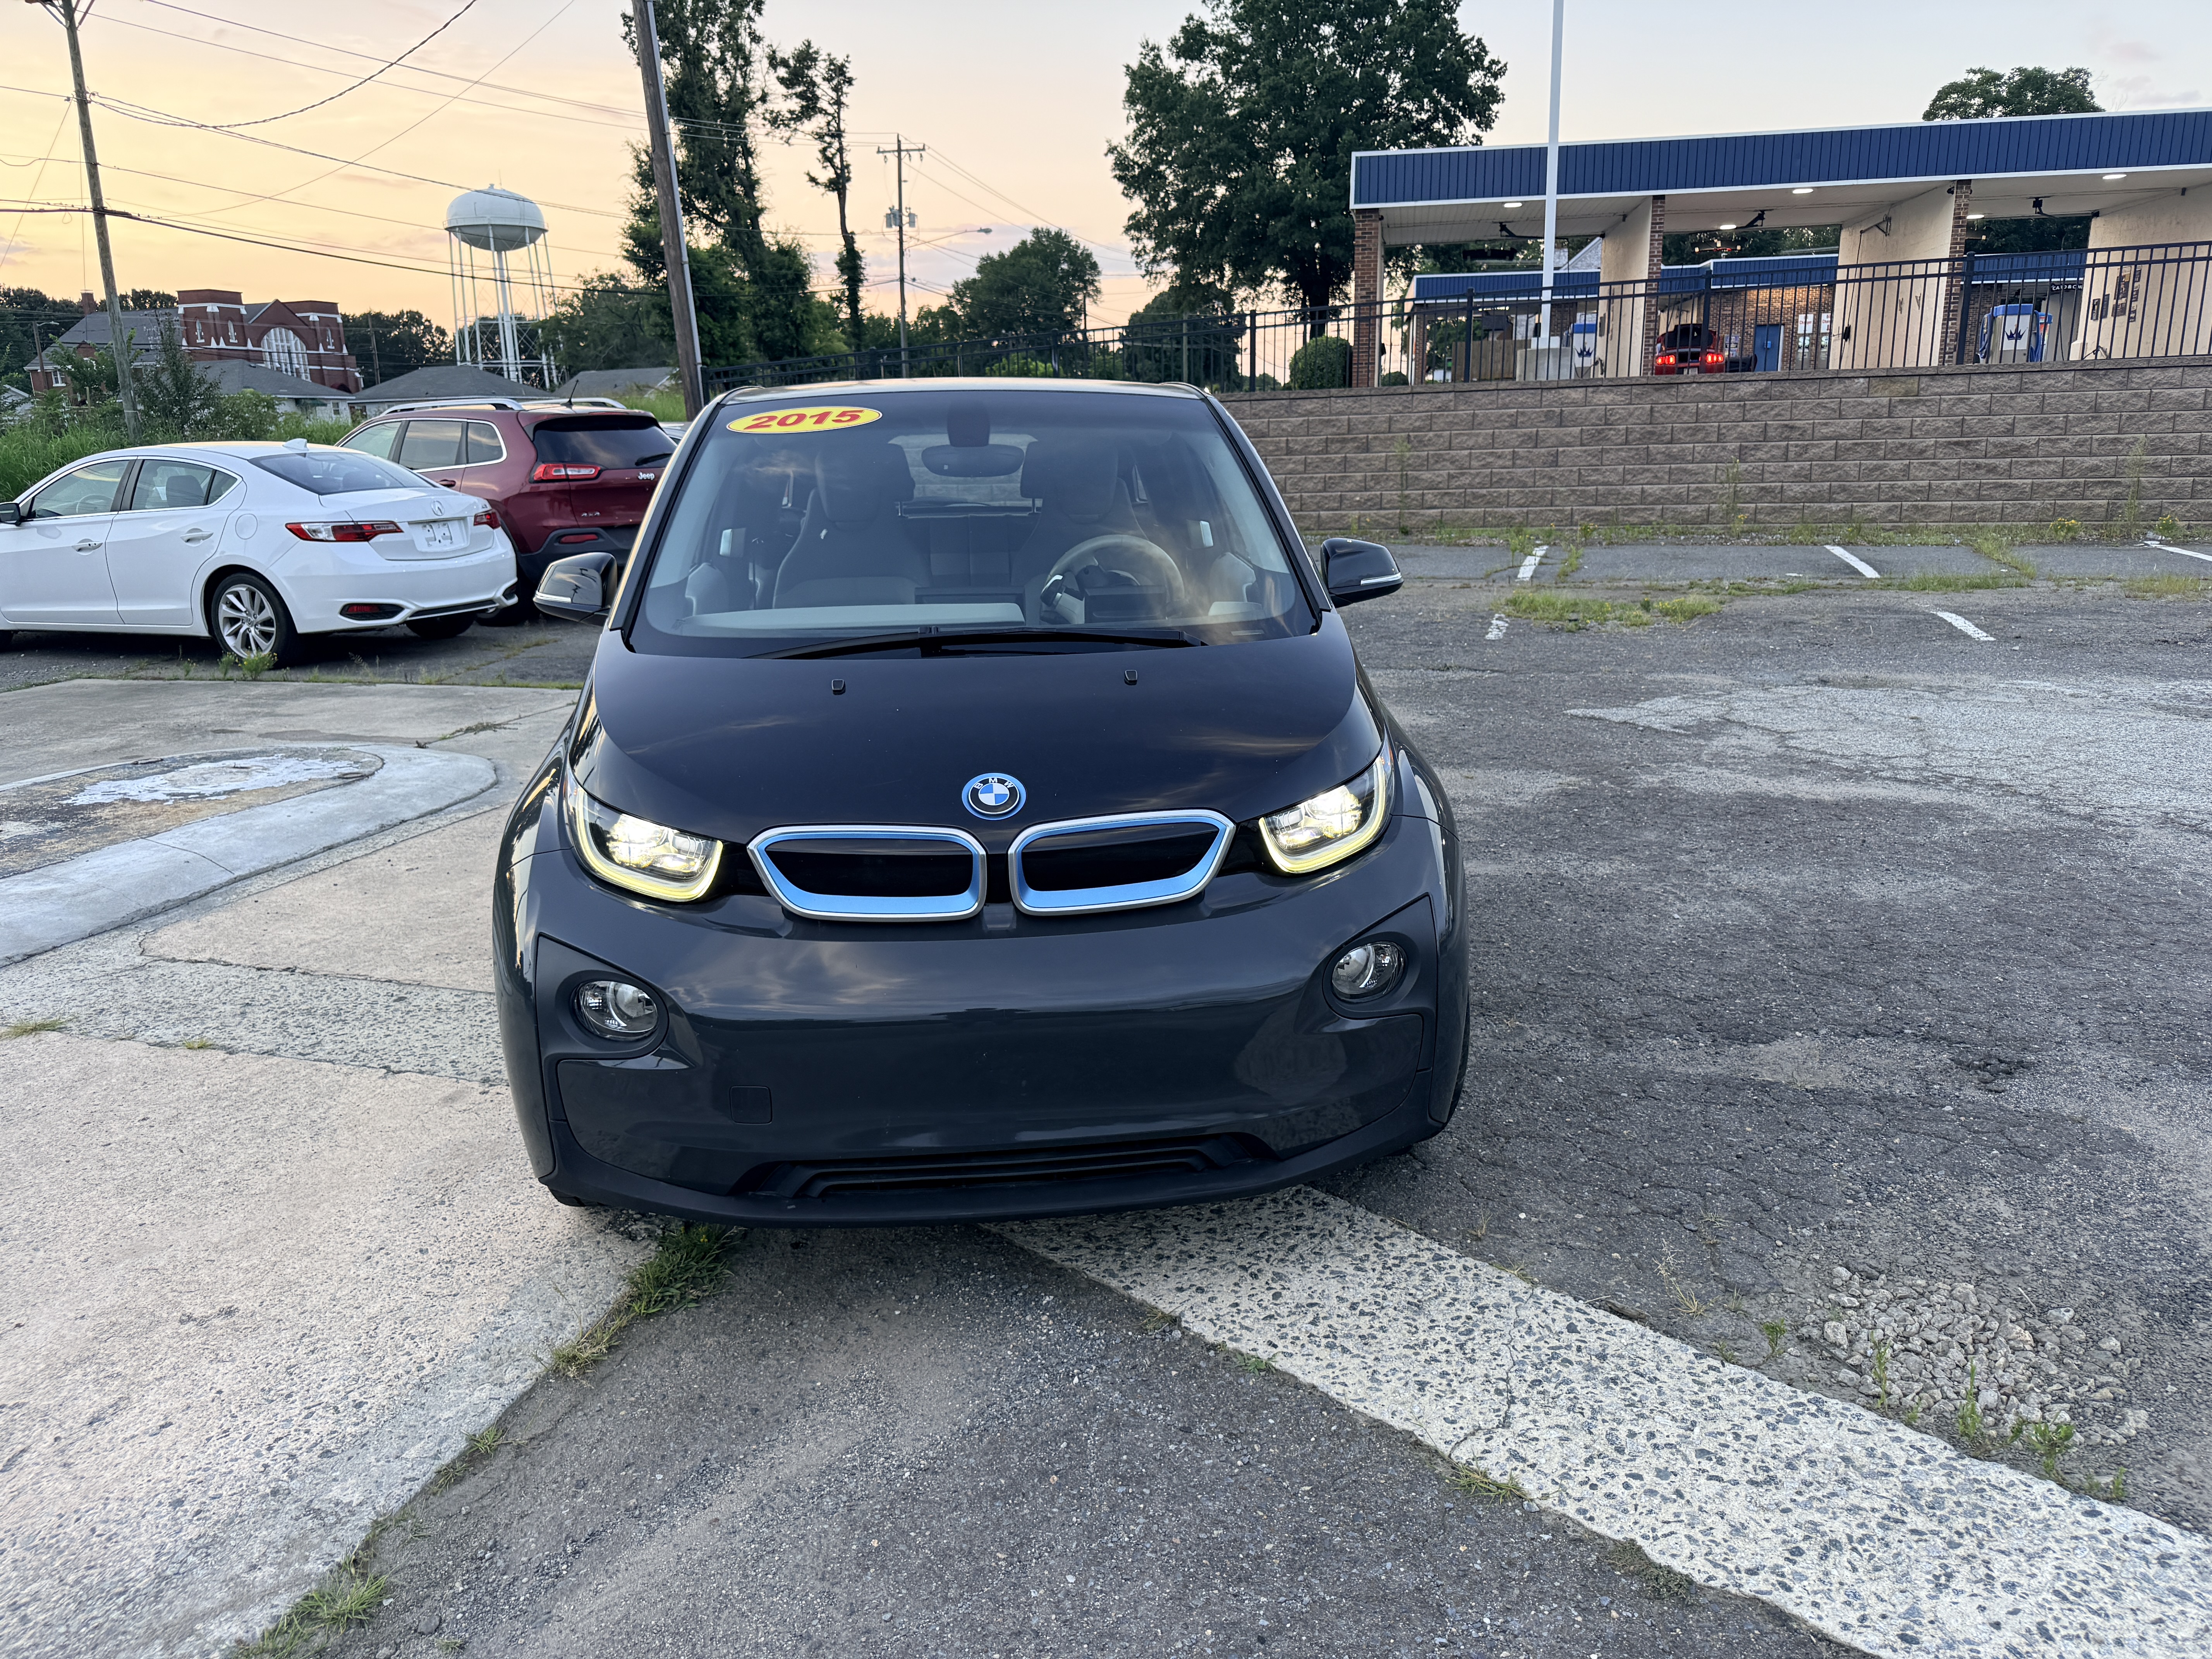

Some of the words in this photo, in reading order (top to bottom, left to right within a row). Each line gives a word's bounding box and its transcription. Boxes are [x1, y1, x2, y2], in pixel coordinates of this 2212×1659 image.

[743, 410, 865, 430] 2015
[638, 471, 655, 481] Jeep
[974, 778, 1014, 789] BMW
